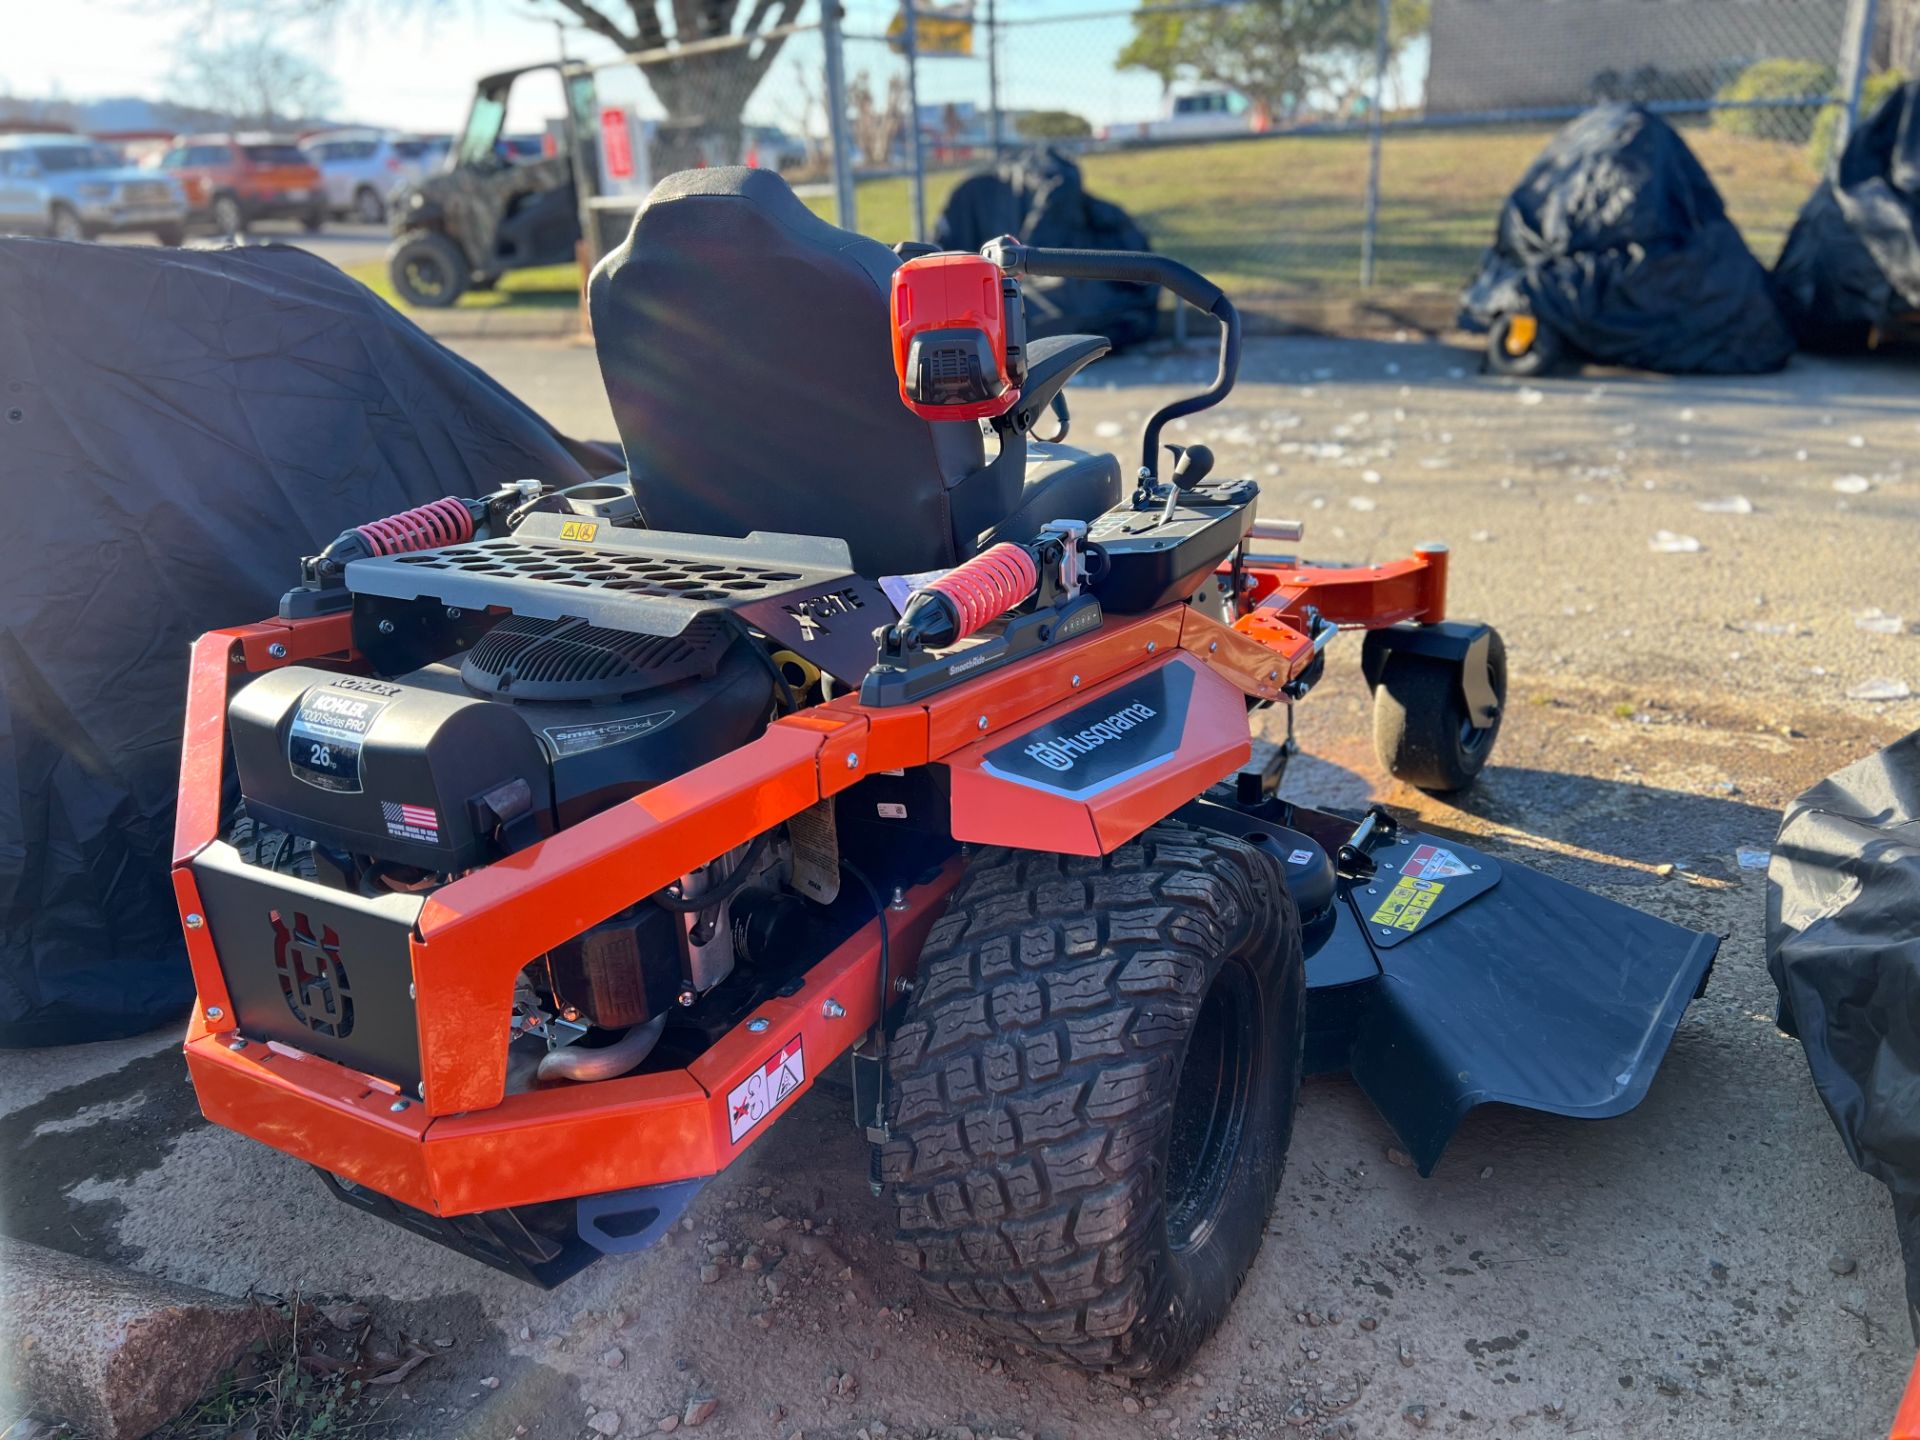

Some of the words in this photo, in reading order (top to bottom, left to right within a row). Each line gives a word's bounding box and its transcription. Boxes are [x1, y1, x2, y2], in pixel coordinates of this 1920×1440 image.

[312, 695, 369, 719] KOHLER
[301, 709, 322, 724] 7000
[321, 712, 346, 729] Series
[344, 719, 366, 732] PRO
[1048, 701, 1157, 760] Husqvarna
[310, 743, 331, 767] 26
